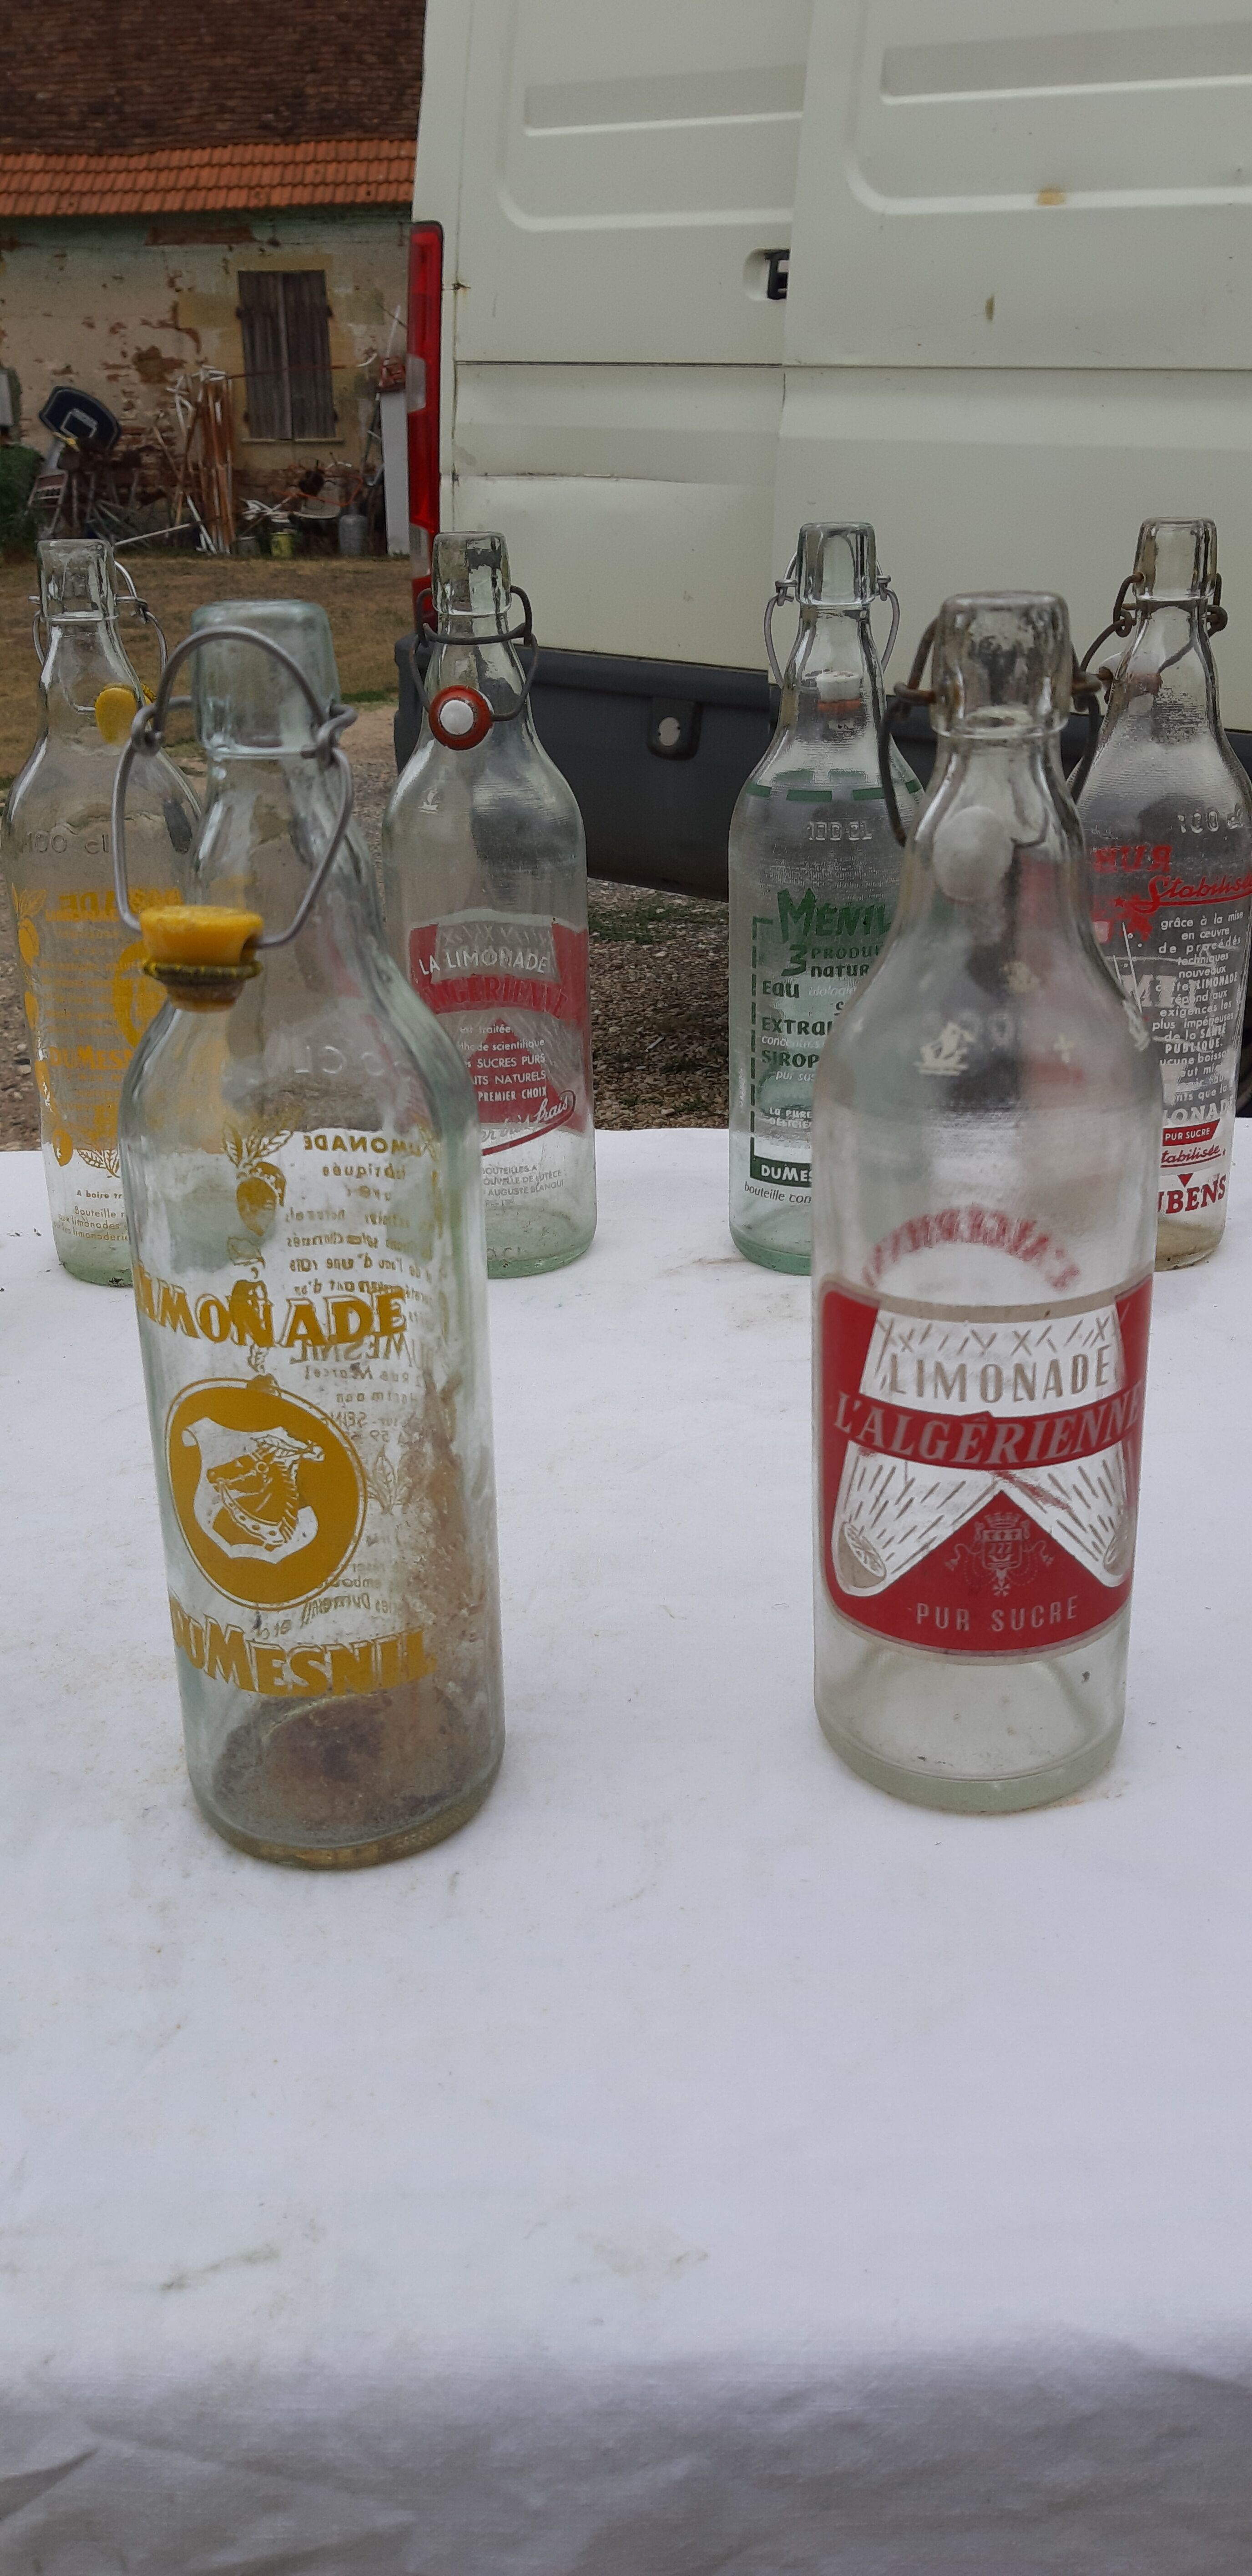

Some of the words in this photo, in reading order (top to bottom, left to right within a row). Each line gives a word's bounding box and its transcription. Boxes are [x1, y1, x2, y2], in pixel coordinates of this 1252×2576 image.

[1161, 917, 1194, 931] grâce
[1200, 915, 1207, 926] à
[1214, 912, 1223, 924] la
[1228, 910, 1243, 922] mise
[1181, 932, 1195, 940] en
[1158, 942, 1177, 954] de
[1186, 935, 1242, 955] procédés
[419, 955, 440, 976] LA
[446, 949, 548, 974] LIMONADE
[781, 944, 808, 976] 3
[1177, 952, 1229, 966] techniques
[1179, 965, 1227, 979] nouveaux
[1196, 971, 1238, 990] LIMONADE
[1212, 989, 1228, 1000] aux
[1160, 1004, 1217, 1019] exigences
[1220, 999, 1232, 1011] les
[1151, 1018, 1176, 1032] plus
[1164, 1030, 1181, 1041] de
[1185, 1029, 1196, 1041] la
[492, 1038, 545, 1052] scientifique
[477, 1057, 517, 1069] SUCRES
[521, 1053, 546, 1066] PURS
[1197, 1050, 1227, 1063] boisso
[495, 1070, 547, 1085] NATURELS
[478, 1090, 517, 1102] PREMIER
[521, 1086, 547, 1099] CHOIX
[1198, 1089, 1217, 1101] que
[1165, 1132, 1183, 1142] PUR
[1185, 1127, 1211, 1139] SUCRE
[86, 1189, 110, 1199] boire
[487, 1185, 529, 1197] AUGUSTE
[744, 1181, 785, 1202] bouteille
[74, 1205, 116, 1218] Bouteille
[71, 1215, 120, 1229] limonades
[889, 1344, 1111, 1403] LIMONADE
[915, 1602, 970, 1631] PUR
[991, 1595, 1079, 1632] SUCRE
